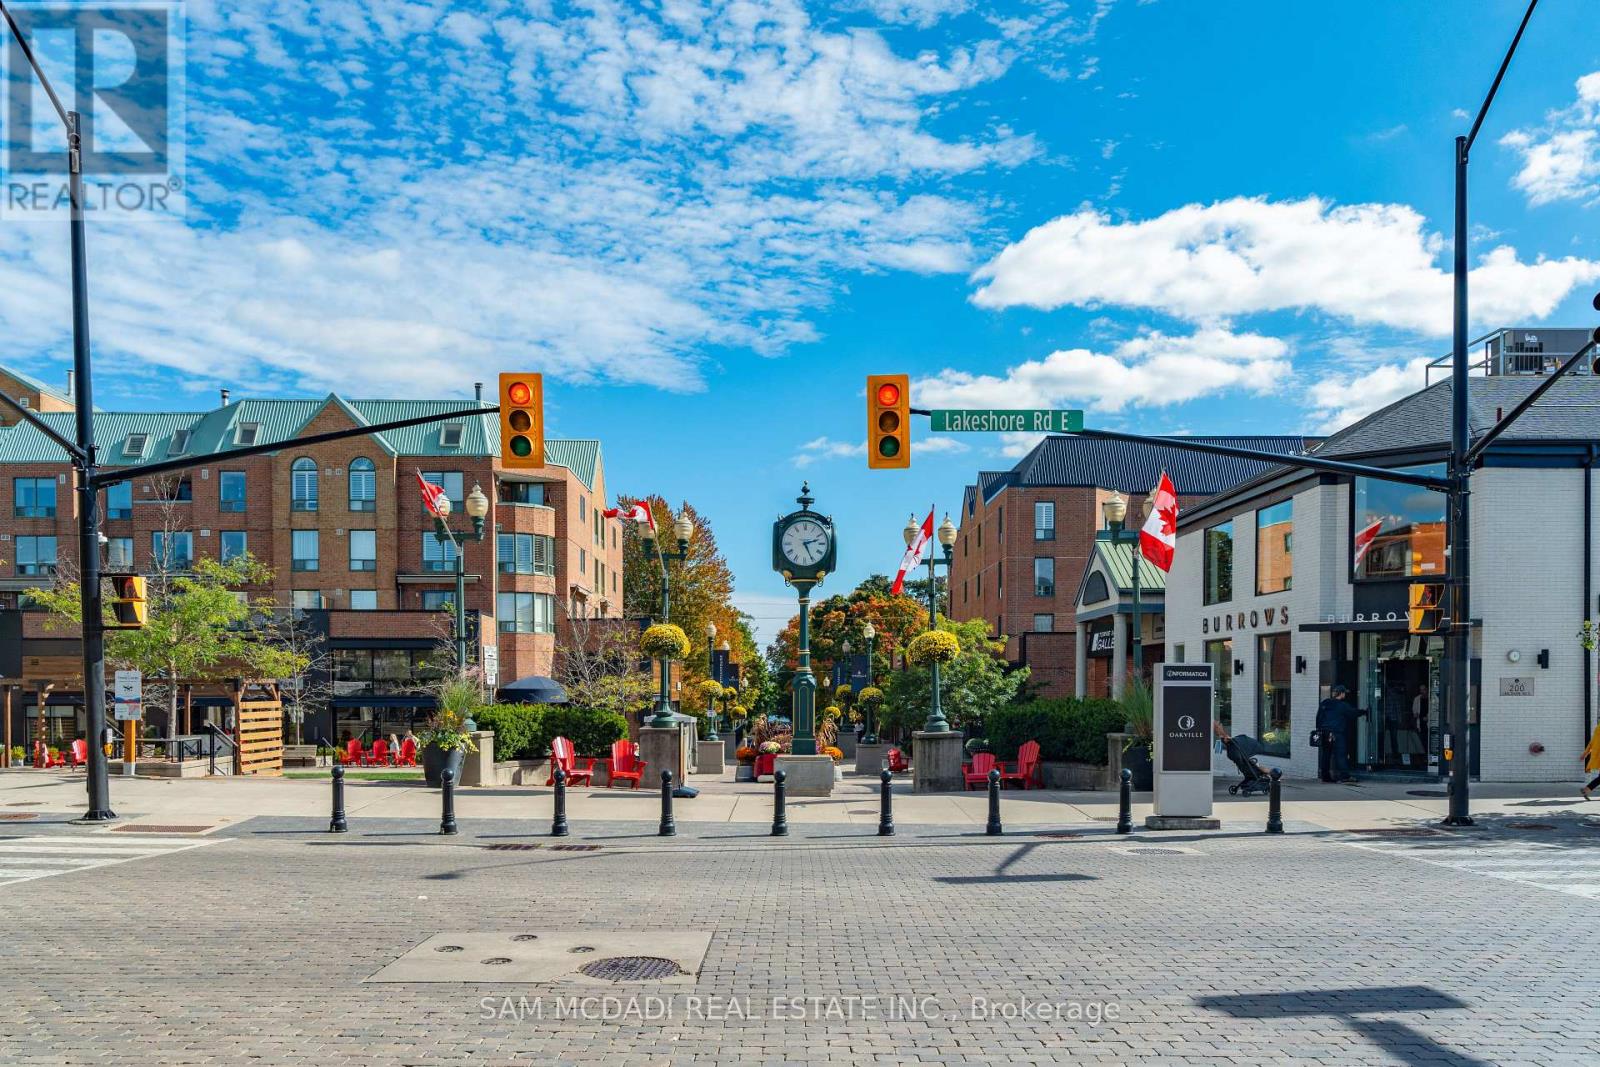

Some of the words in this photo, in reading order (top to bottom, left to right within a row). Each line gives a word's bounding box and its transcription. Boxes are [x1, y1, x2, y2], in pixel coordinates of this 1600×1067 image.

[945, 410, 1025, 431] Lakeshore
[1033, 411, 1053, 431] Rd
[1061, 411, 1069, 431] E
[1202, 605, 1289, 634] BURROWS
[1509, 684, 1525, 692] 200
